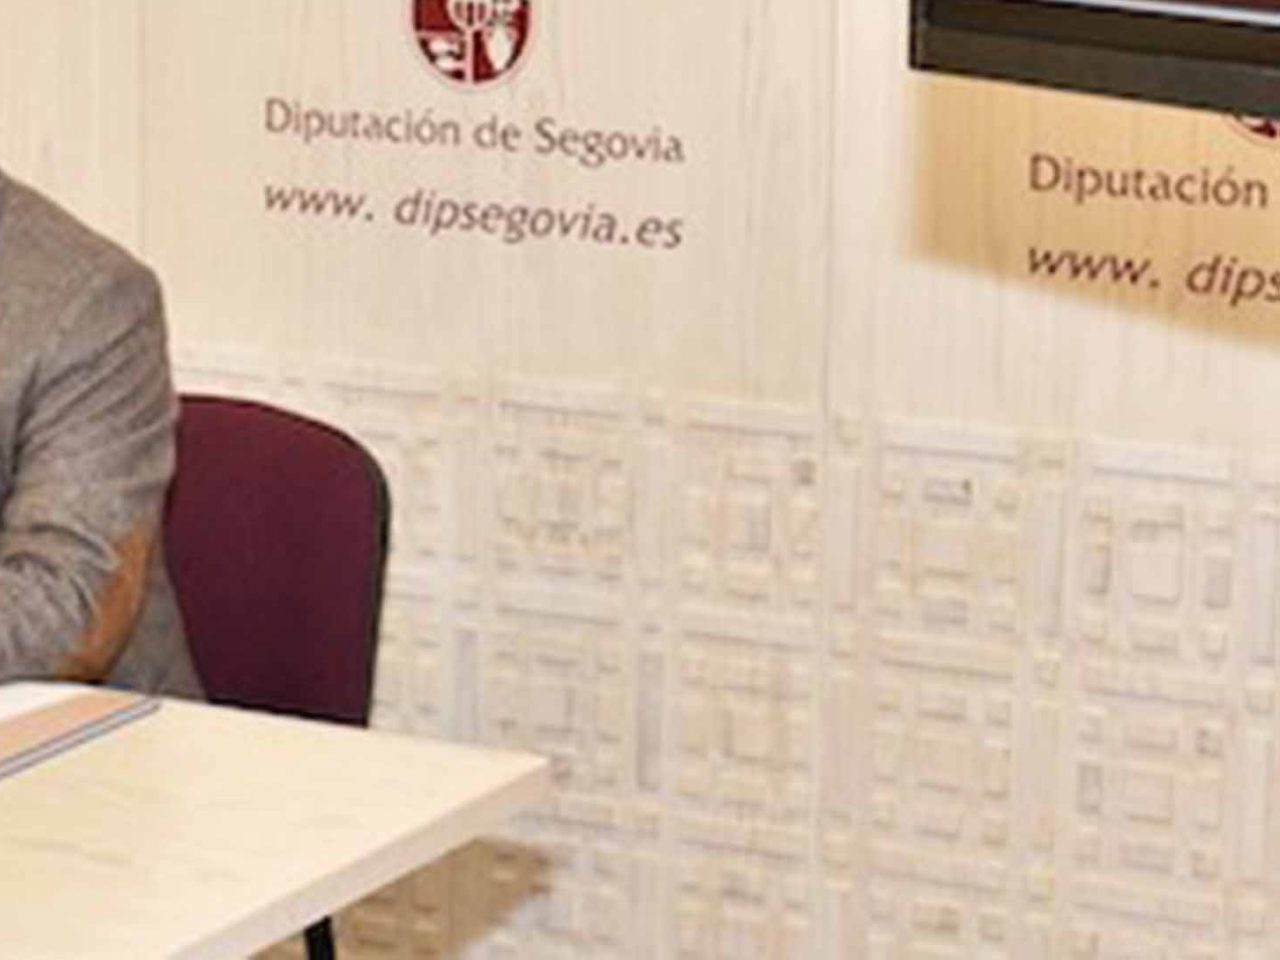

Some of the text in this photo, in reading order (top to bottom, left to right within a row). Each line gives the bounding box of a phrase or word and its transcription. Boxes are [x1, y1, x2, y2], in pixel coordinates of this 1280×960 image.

[264, 97, 686, 168] Diputación de Segovia
[1030, 153, 1269, 208] Diputación
[263, 183, 684, 250] www. dipsegovia.es
[1028, 246, 1160, 288] www.
